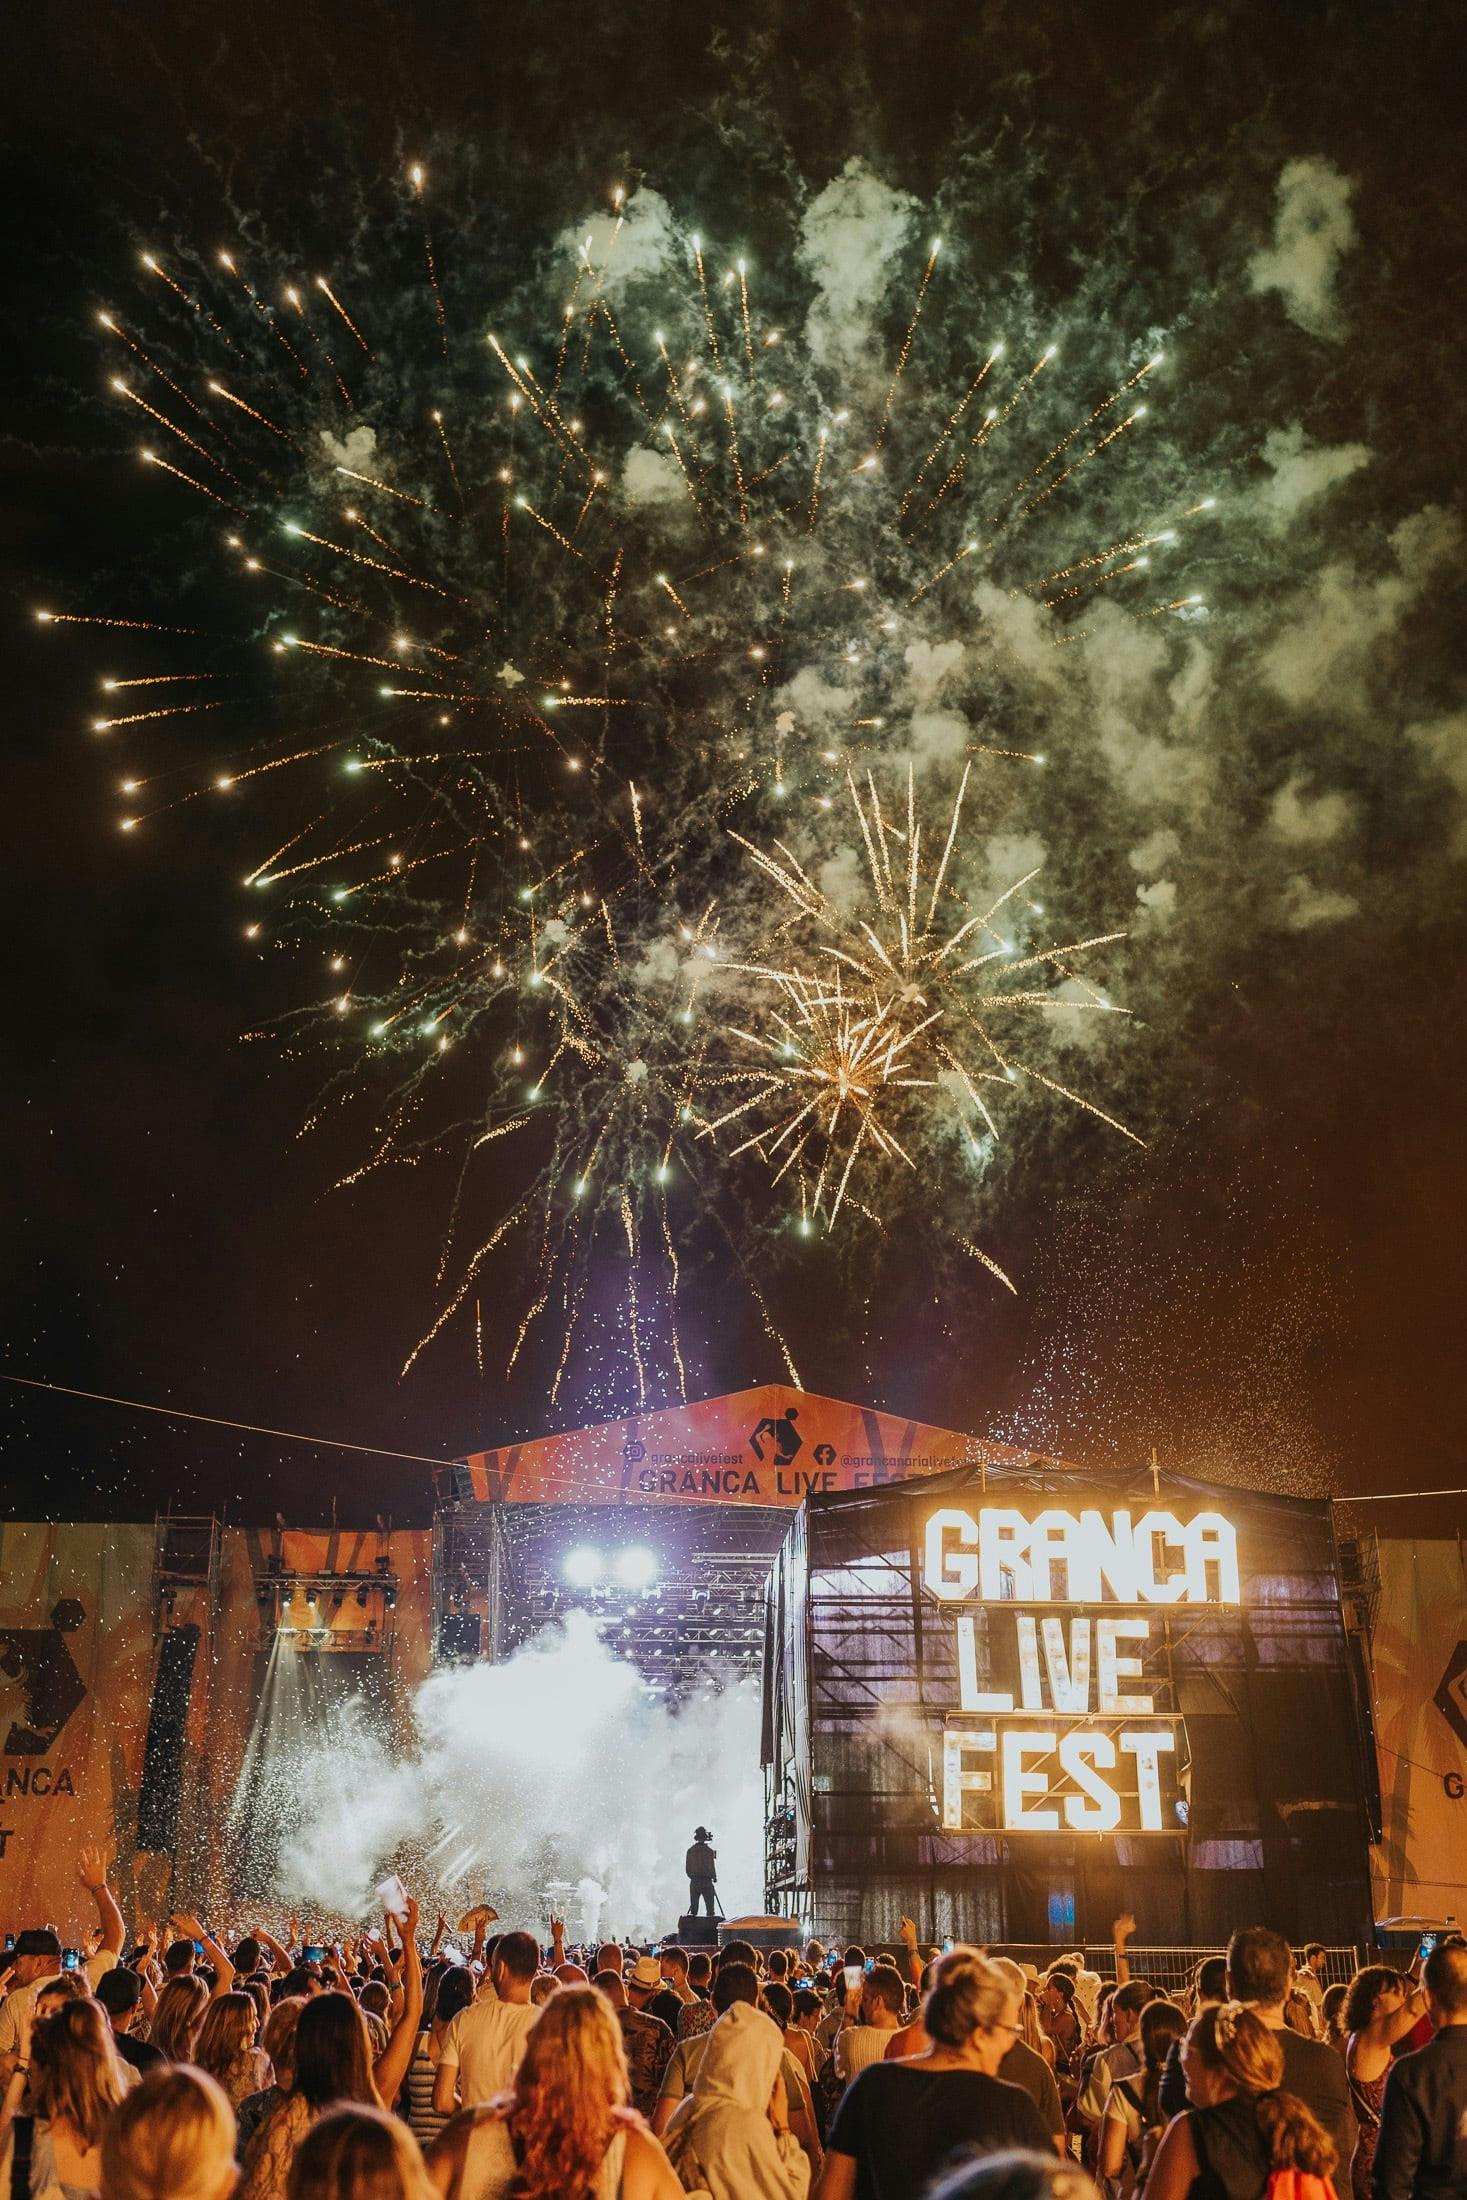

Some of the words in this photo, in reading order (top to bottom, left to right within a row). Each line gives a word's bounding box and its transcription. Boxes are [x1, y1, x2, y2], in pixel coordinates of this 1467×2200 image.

[639, 1470, 761, 1494] GRANCA
[777, 1472, 838, 1495] LIVE
[854, 1472, 923, 1488] FE
[924, 1508, 1240, 1602] GRANCA
[957, 1616, 1154, 1713] LIVE
[0, 1767, 75, 1796] NCA
[943, 1731, 1175, 1831] FEST
